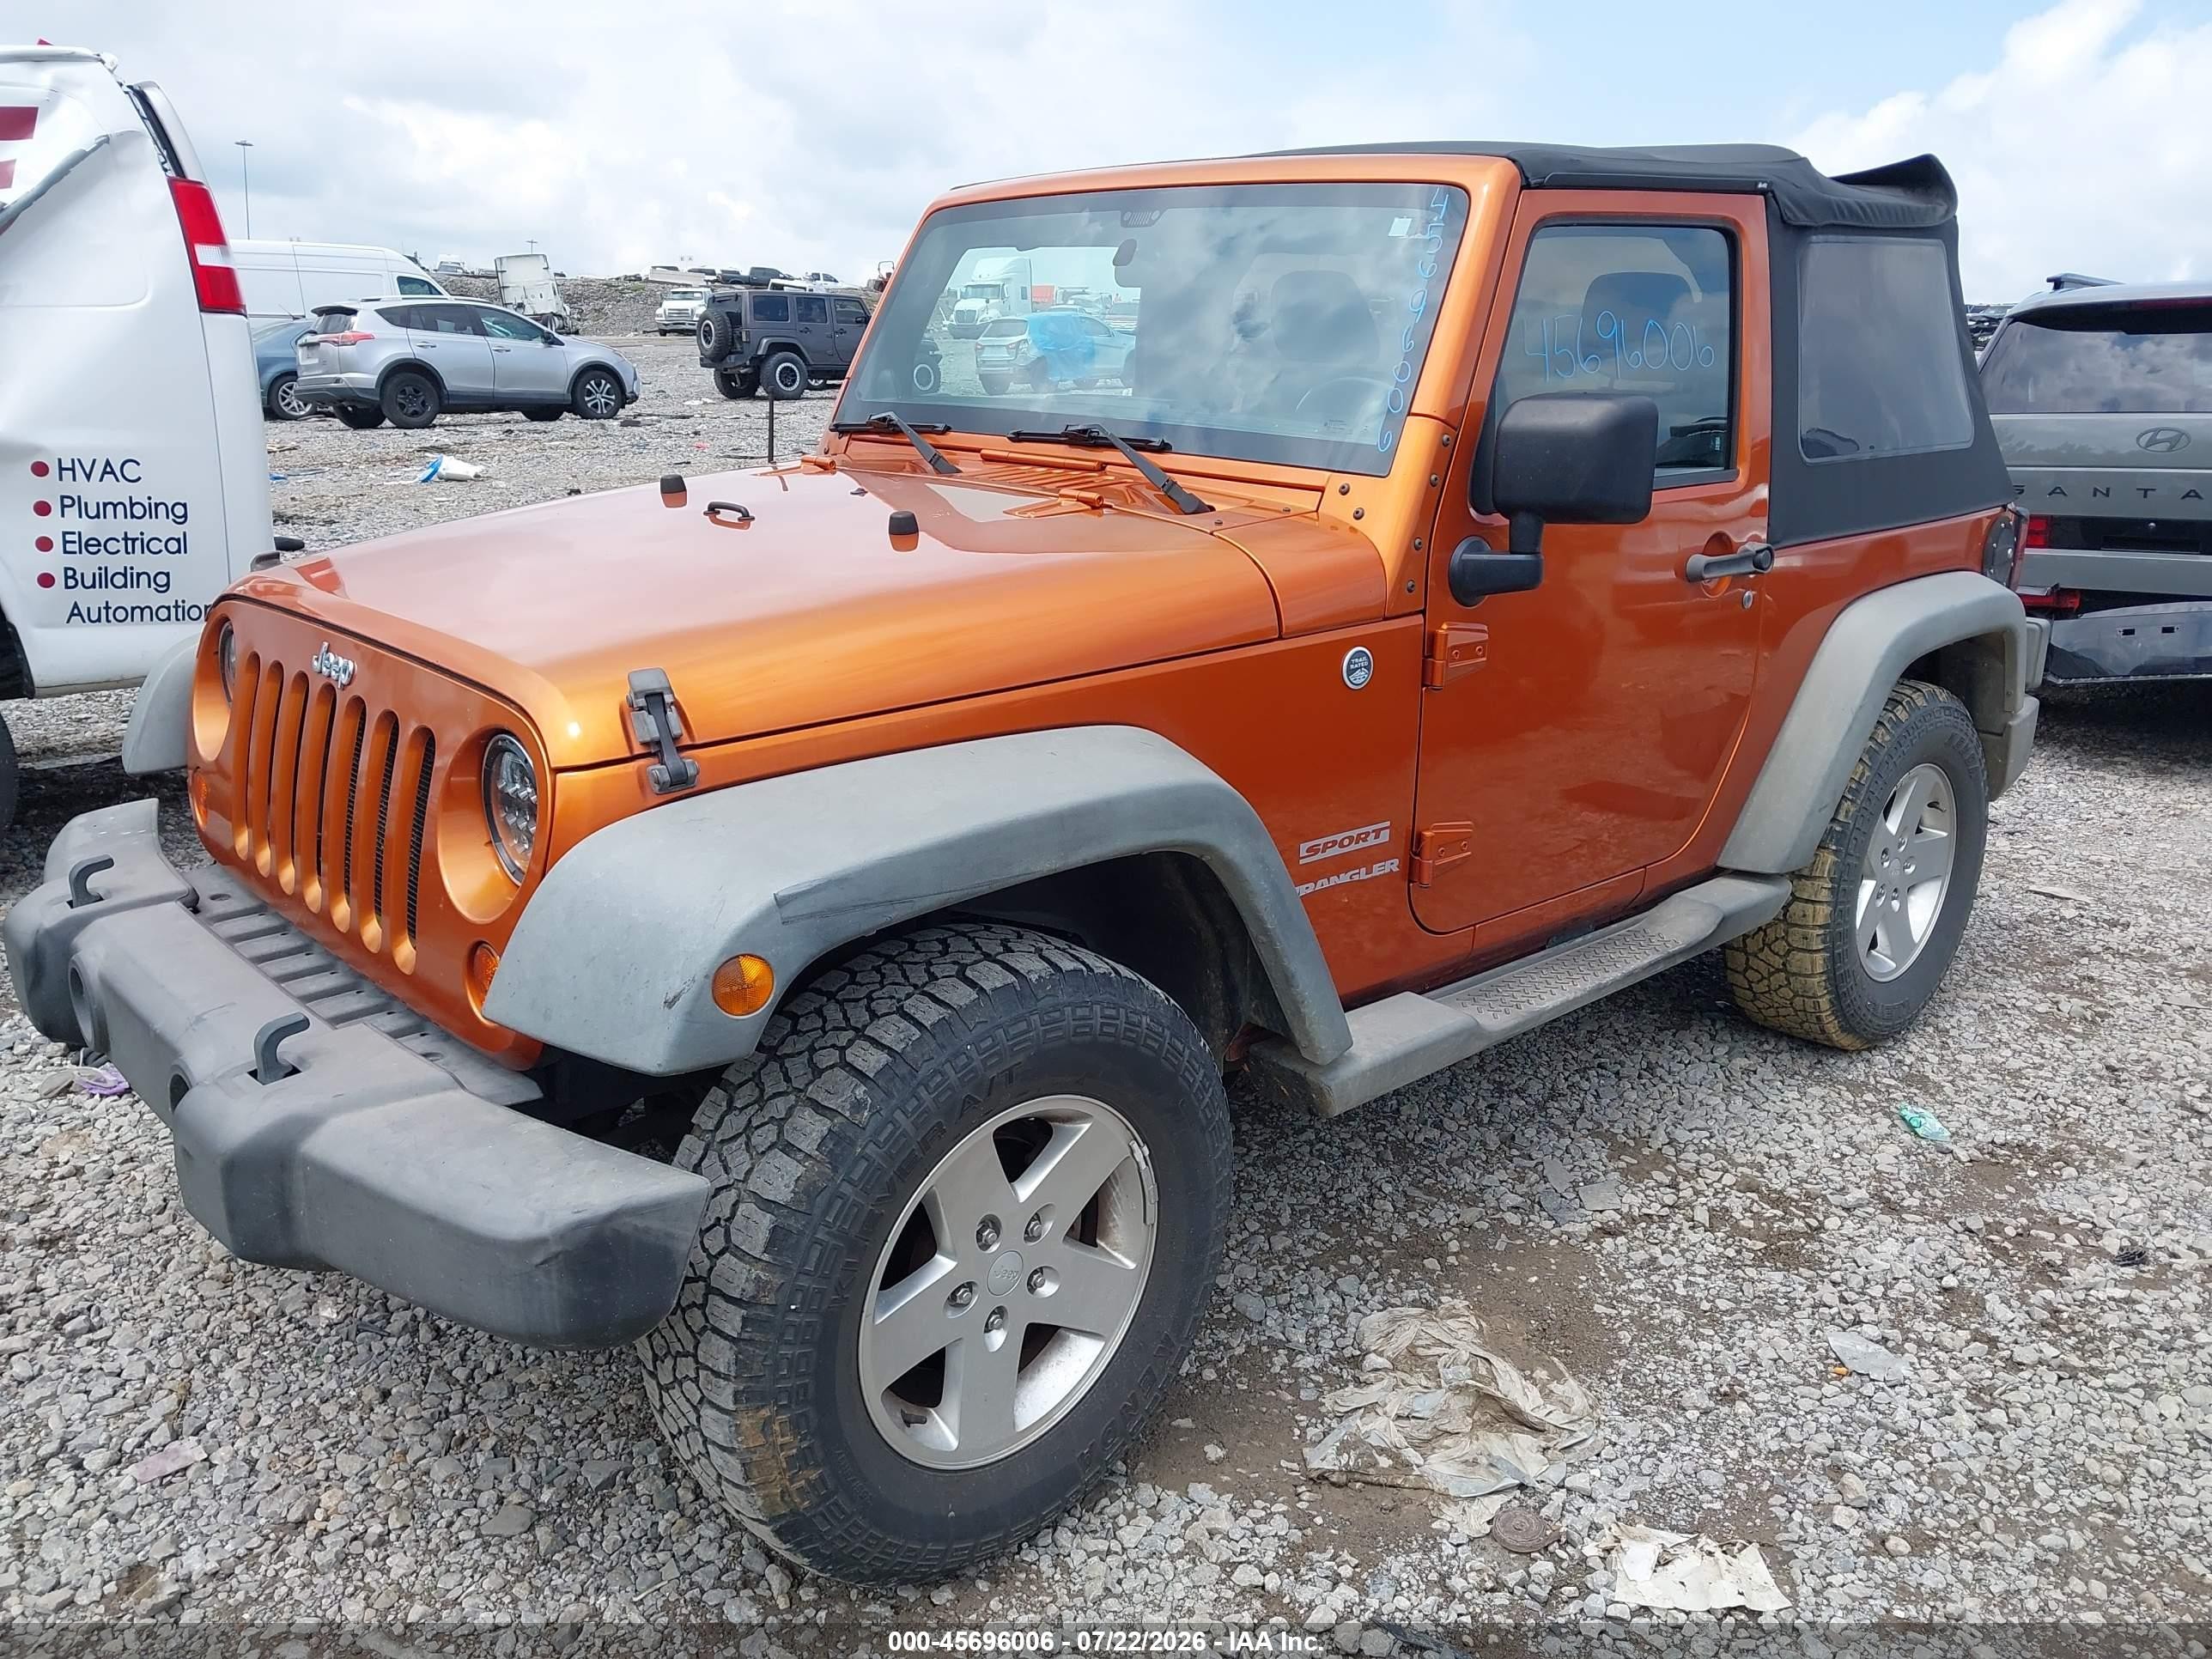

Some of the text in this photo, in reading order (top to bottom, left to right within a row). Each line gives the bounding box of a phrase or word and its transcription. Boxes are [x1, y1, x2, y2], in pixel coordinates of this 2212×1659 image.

[1523, 310, 1715, 383] 45696006
[57, 457, 143, 483] HVAC
[59, 494, 188, 526] Plumbing
[61, 530, 188, 556] Electrical
[63, 565, 171, 594] Building
[312, 641, 355, 689] Jeep
[1350, 661, 1369, 670] RATED
[1351, 656, 1368, 665] TRAIL
[1301, 824, 1389, 859] SPORT
[1296, 858, 1401, 898] RANGLER
[994, 1265, 1020, 1284] Jeep
